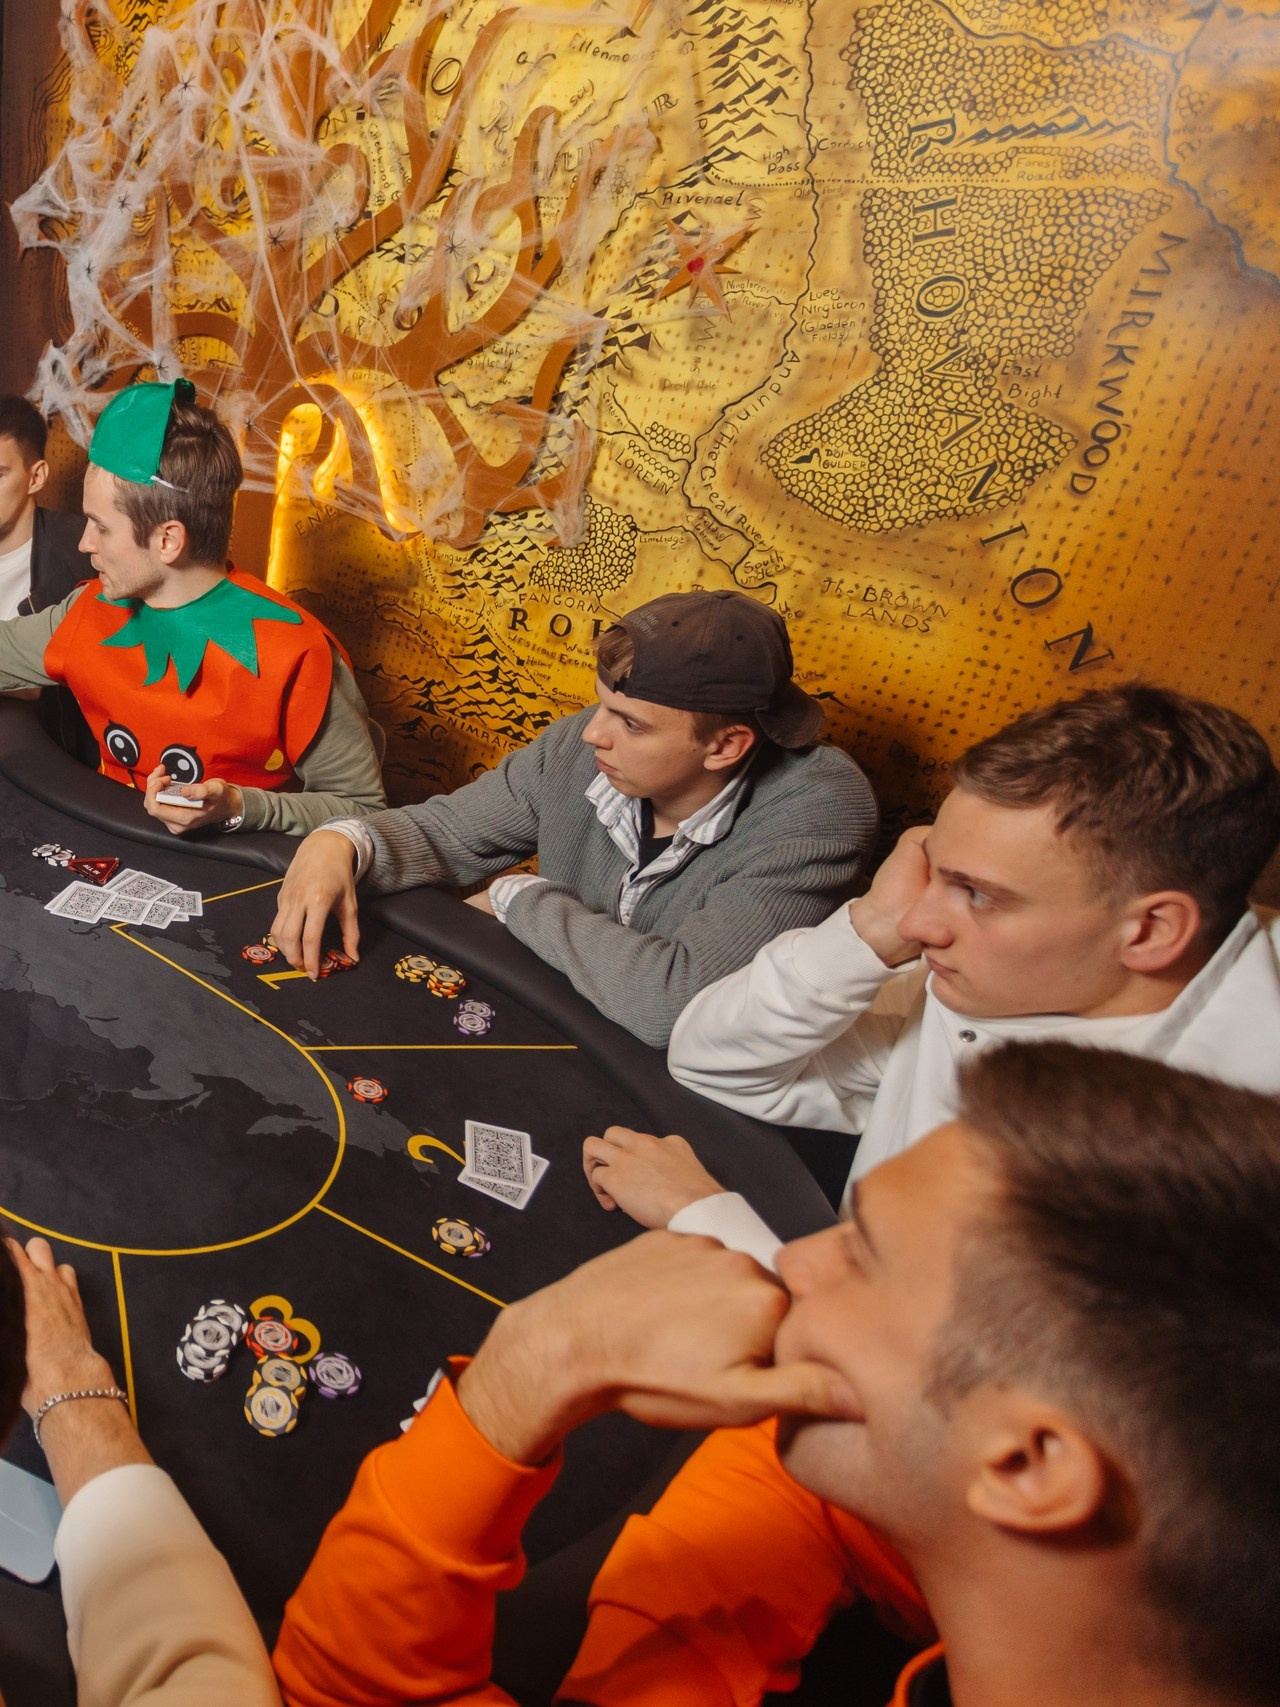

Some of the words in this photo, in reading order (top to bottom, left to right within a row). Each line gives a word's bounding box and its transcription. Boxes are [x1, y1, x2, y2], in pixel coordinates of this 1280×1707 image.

[762, 145, 790, 163] High
[767, 162, 800, 175] Pass
[1001, 359, 1042, 378] East
[1007, 383, 1063, 407] Bight
[743, 551, 783, 575] South
[519, 592, 600, 614] FANGORN
[862, 587, 954, 618] BROWN
[846, 604, 933, 632] LANDS
